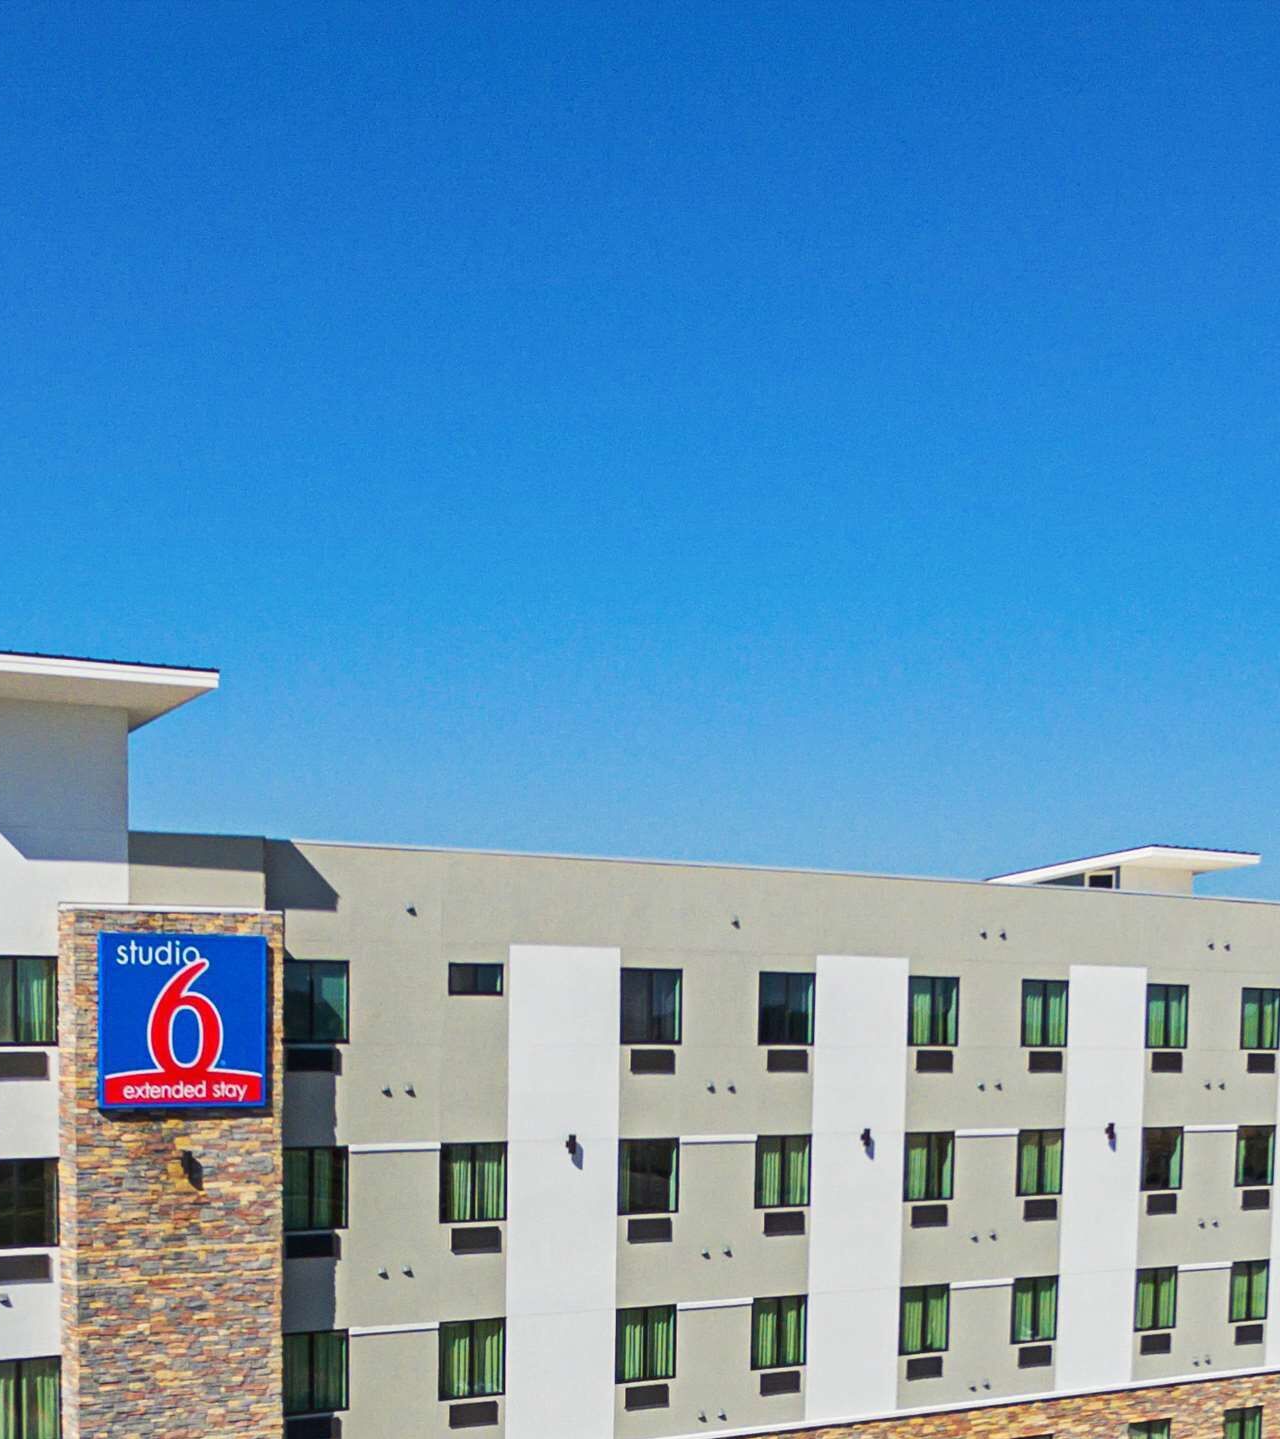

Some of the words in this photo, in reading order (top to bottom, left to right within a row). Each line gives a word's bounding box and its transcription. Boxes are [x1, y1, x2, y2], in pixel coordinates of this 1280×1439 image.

[116, 940, 200, 966] studio
[147, 958, 223, 1072] 6
[122, 1080, 206, 1099] extended
[212, 1081, 248, 1102] stay
